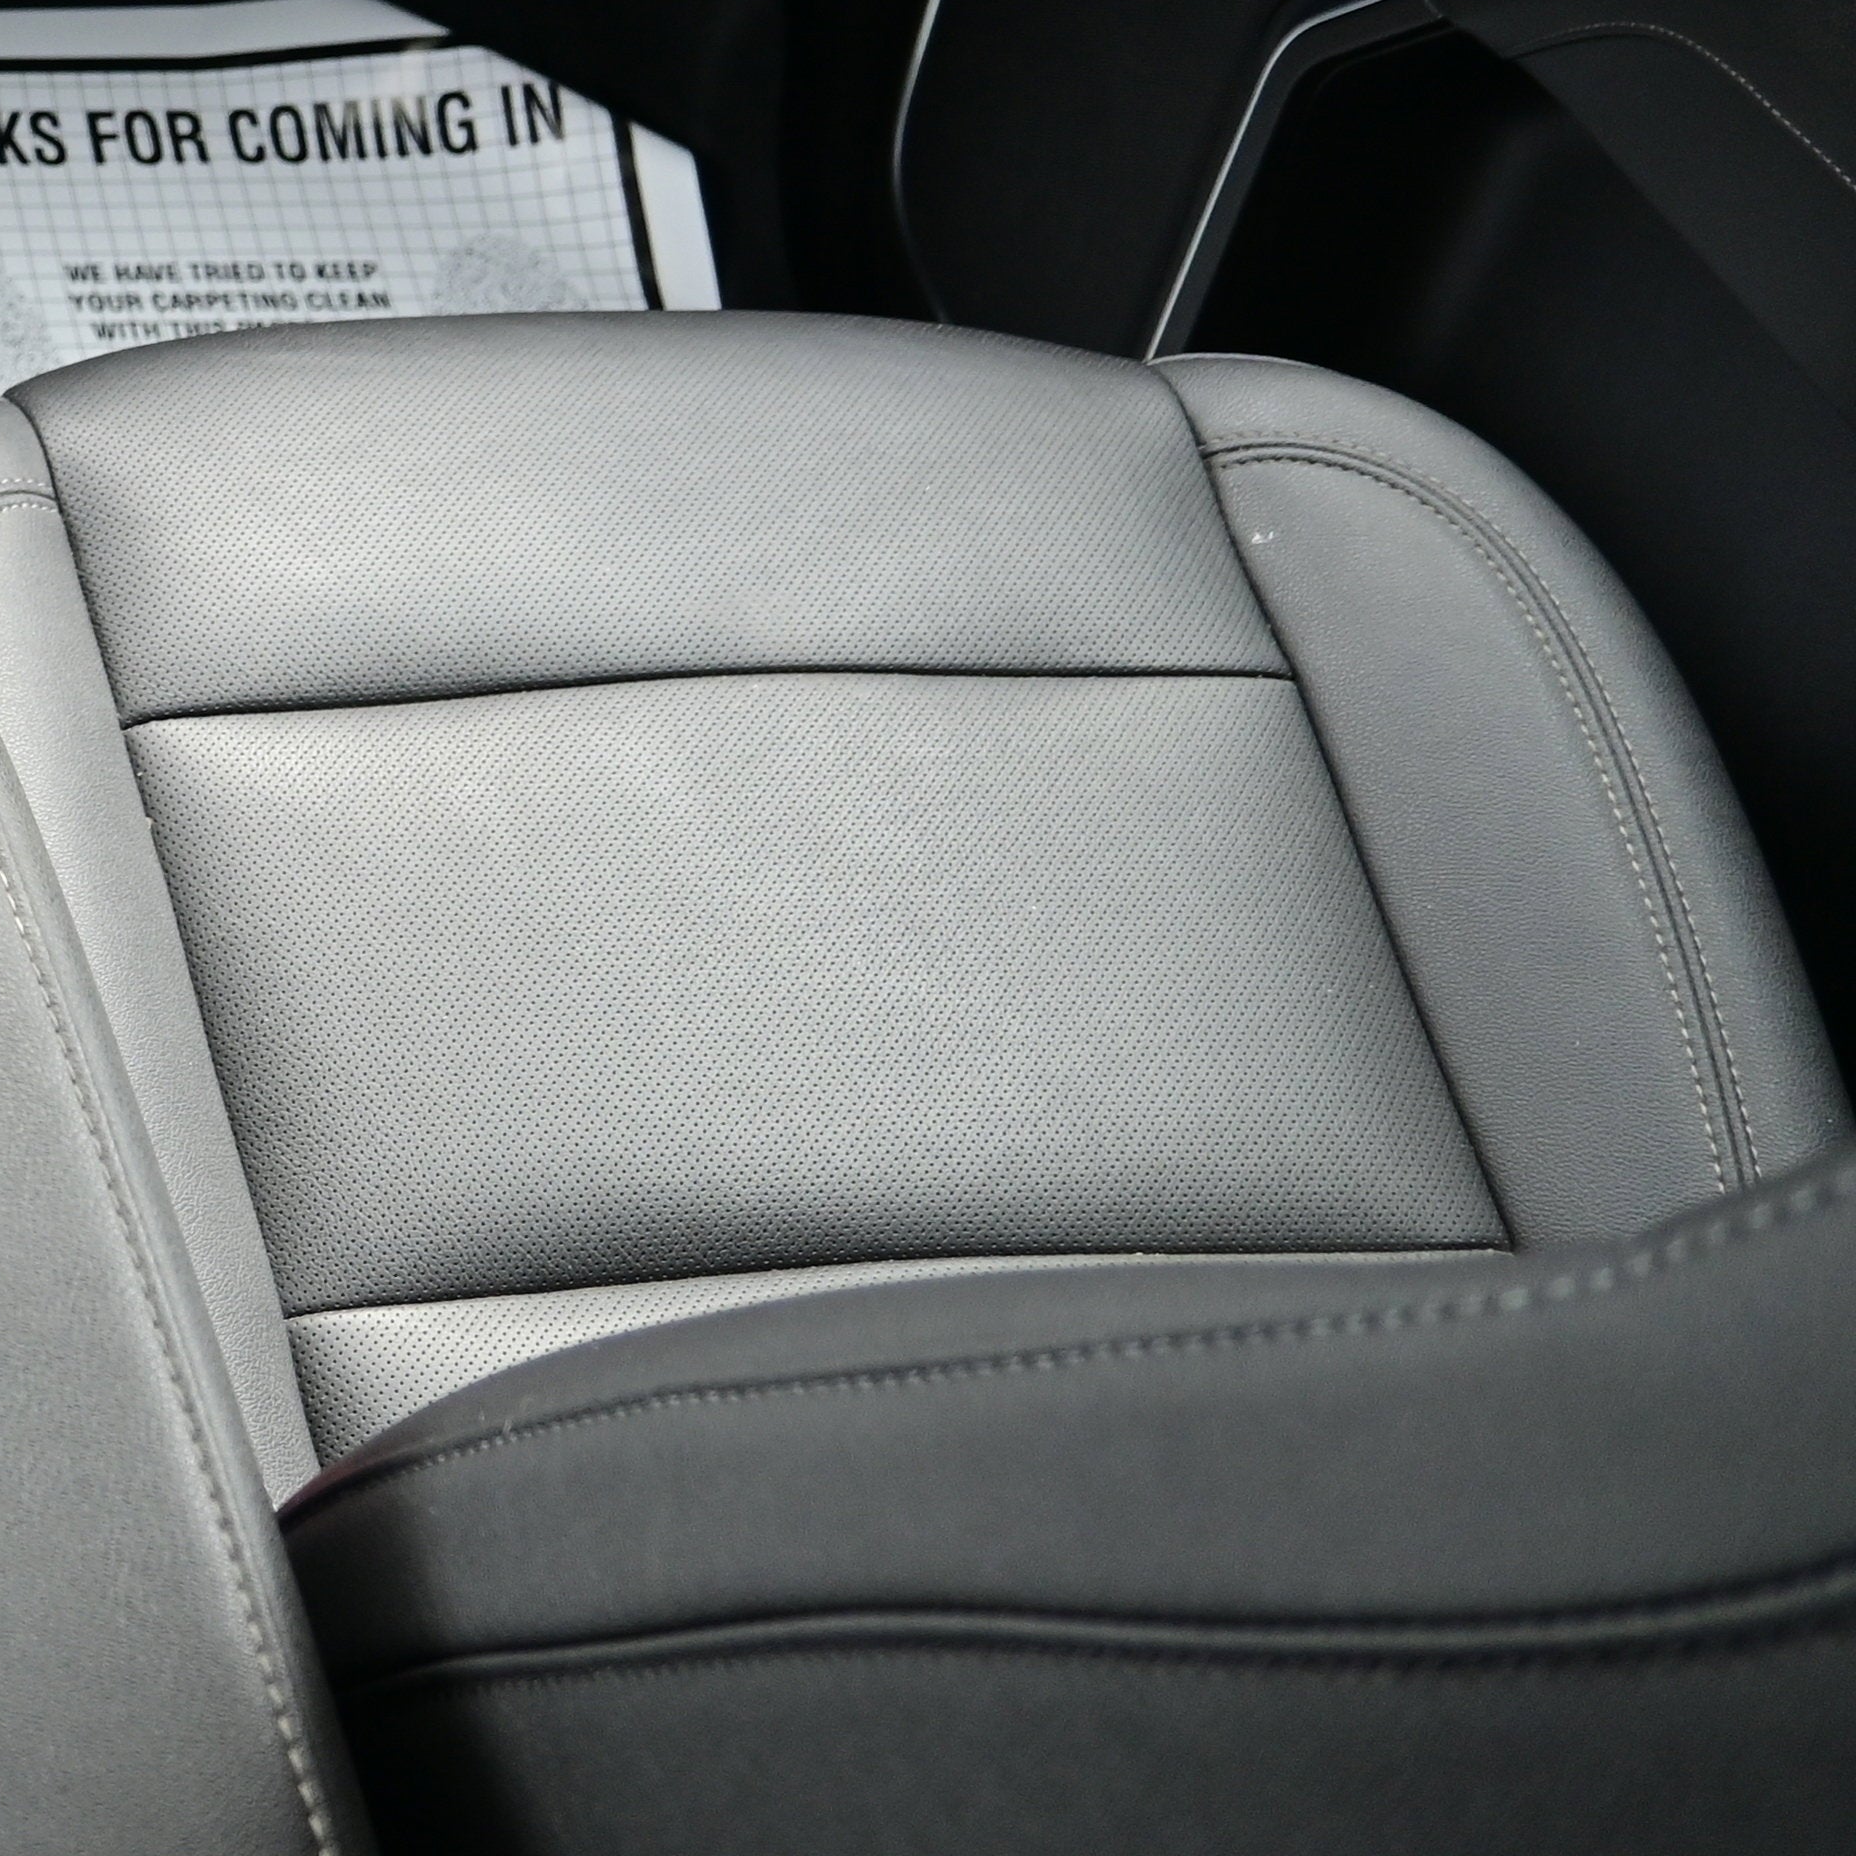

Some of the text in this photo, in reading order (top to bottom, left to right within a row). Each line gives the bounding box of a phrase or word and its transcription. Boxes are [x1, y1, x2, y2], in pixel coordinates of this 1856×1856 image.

[88, 109, 210, 166] FOR
[228, 89, 479, 164] COMING
[501, 82, 565, 147] IN
[65, 261, 378, 282] WE HAVE TRIED TO KEEP
[68, 291, 392, 313] YOUR CARPETING CLEAN
[91, 322, 159, 341] WITH
